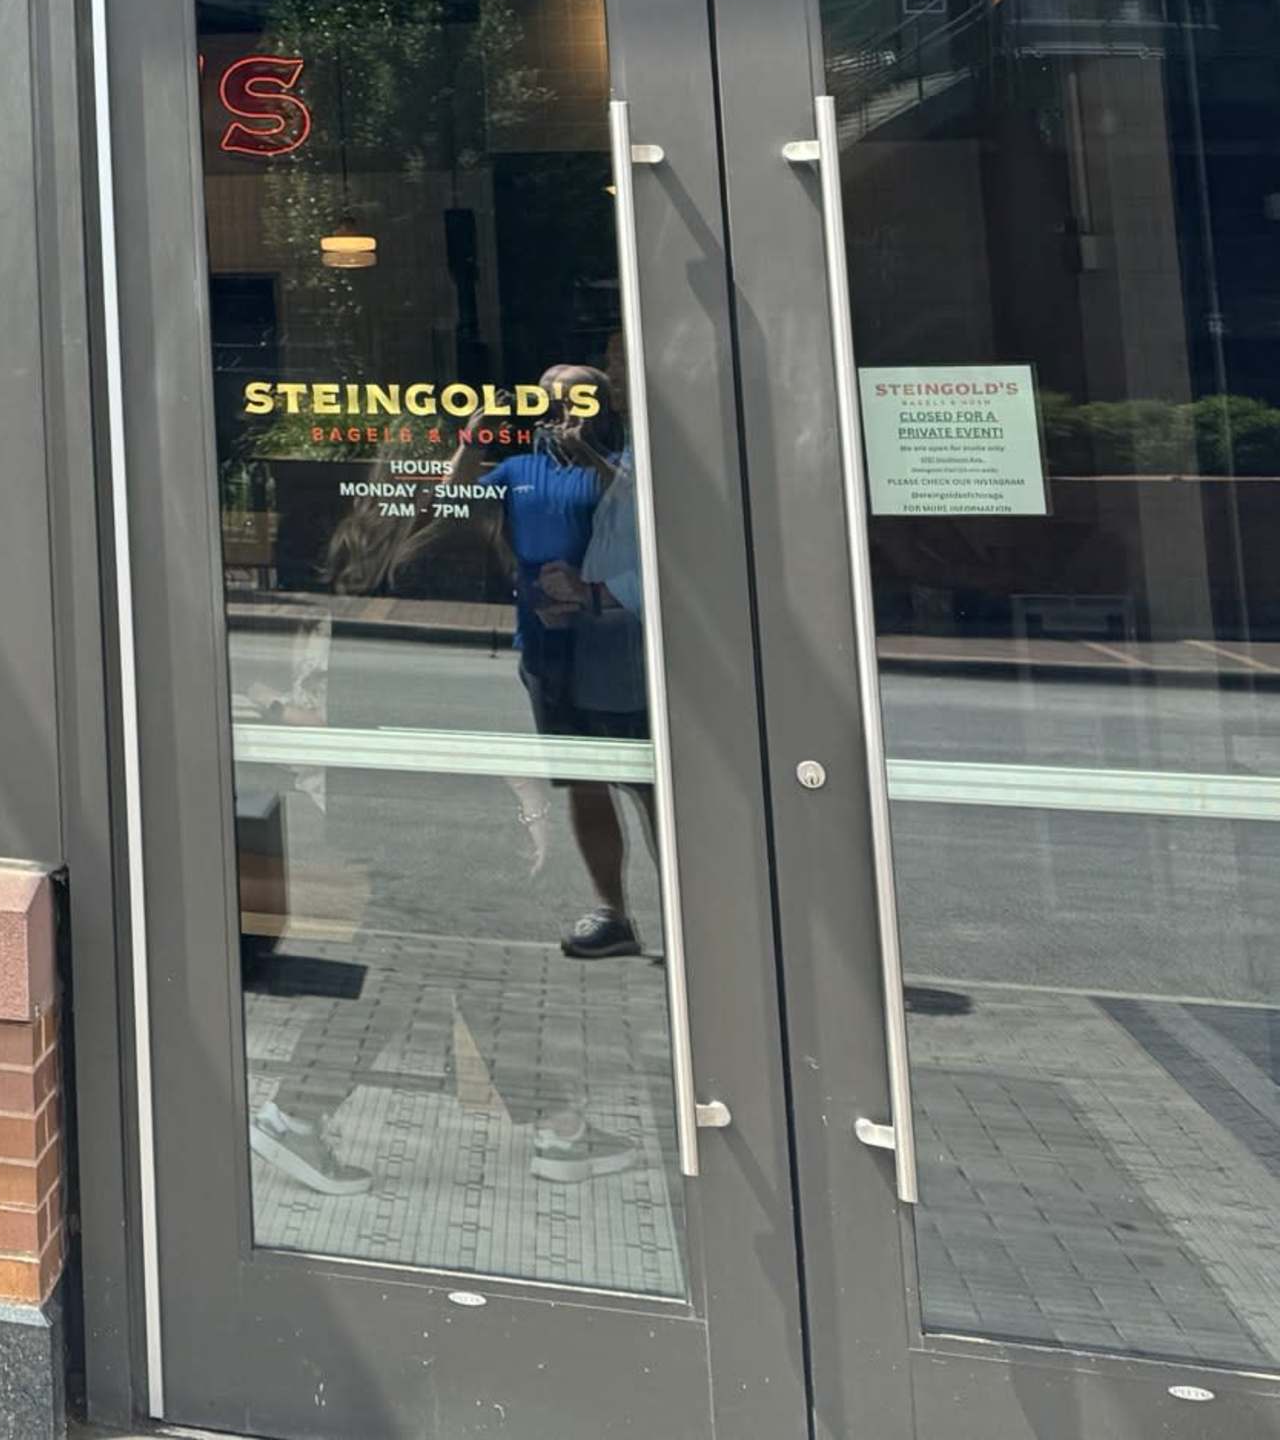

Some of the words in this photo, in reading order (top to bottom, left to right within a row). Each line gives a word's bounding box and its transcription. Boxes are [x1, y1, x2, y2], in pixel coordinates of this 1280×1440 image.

[875, 382, 1019, 397] STEINGOLD'S
[244, 382, 601, 418] STEINGOLD'S
[900, 411, 953, 423] CLOSED
[956, 410, 982, 423] FOR
[311, 427, 413, 445] BAGELS
[458, 426, 533, 445] NOSH
[898, 427, 953, 440] PRIVATE
[956, 427, 1004, 439] EVENT!
[390, 460, 454, 476] HOURS
[340, 482, 416, 498] MONDAY
[434, 484, 508, 500] SUNDAY
[378, 503, 416, 518] 7AM
[432, 504, 470, 519] 7PM
